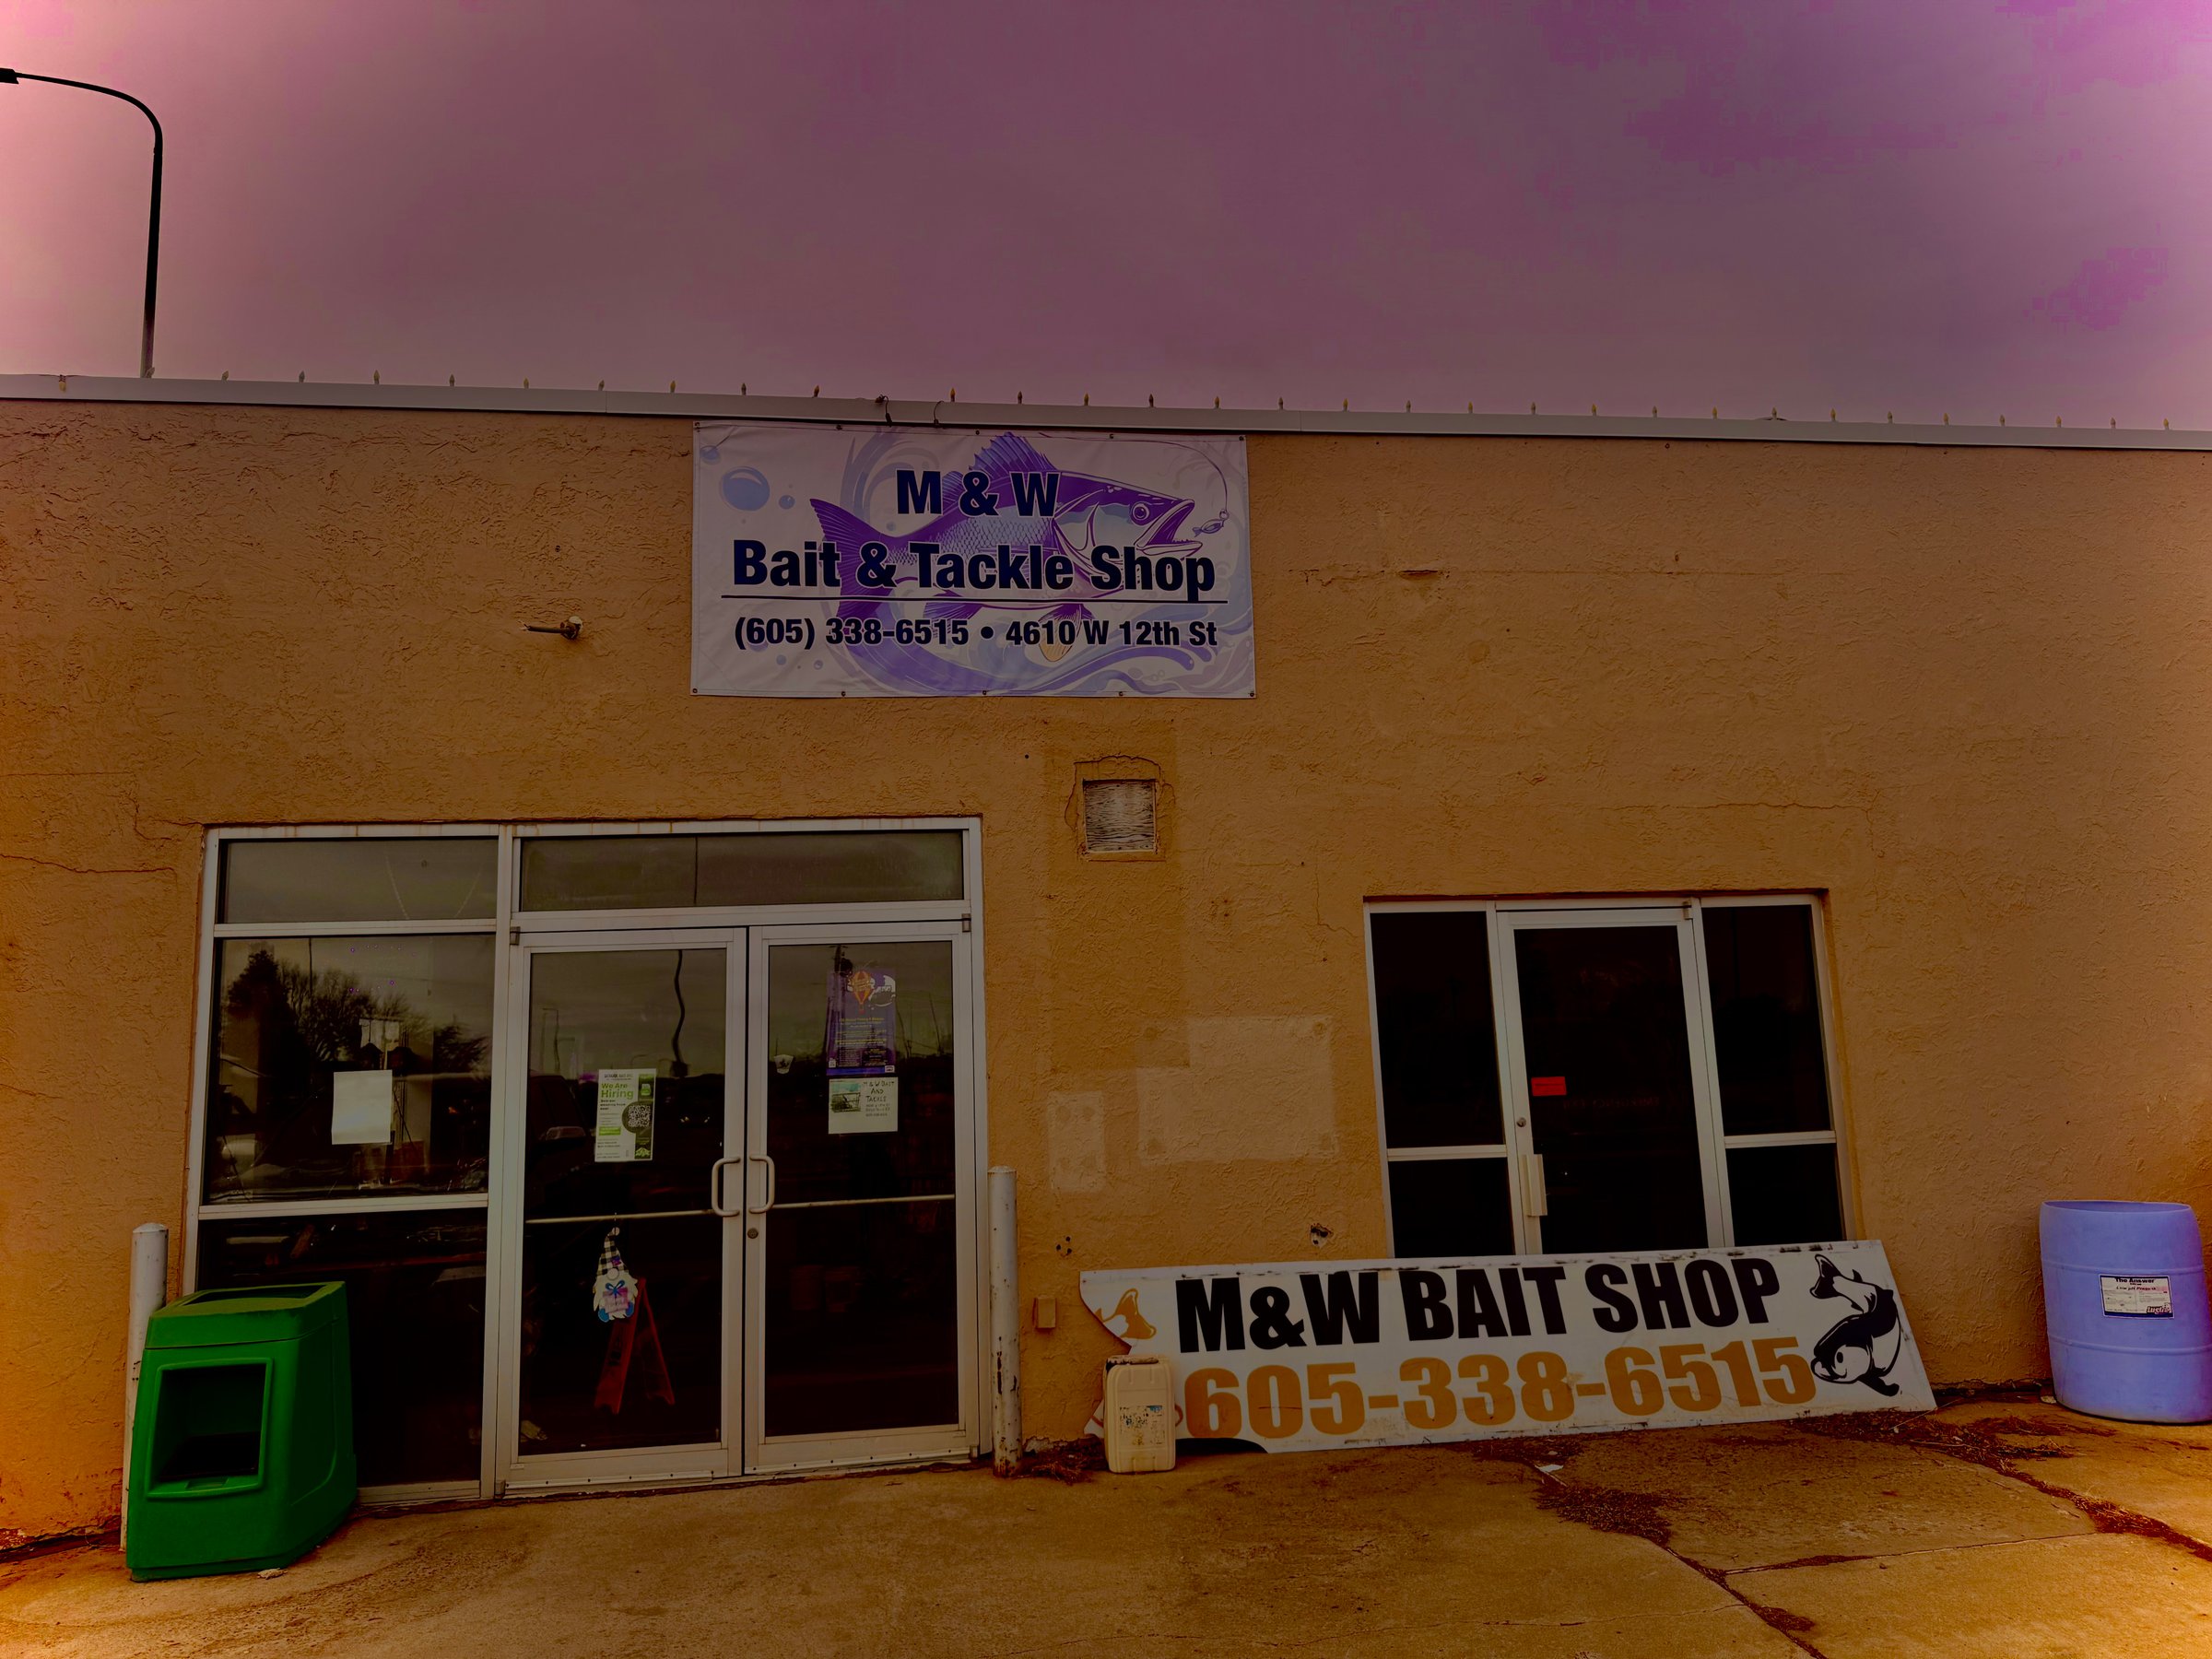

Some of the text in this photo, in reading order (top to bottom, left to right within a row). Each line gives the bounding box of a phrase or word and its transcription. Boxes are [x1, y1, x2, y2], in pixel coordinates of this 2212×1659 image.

[896, 469, 1061, 516] M & W
[734, 539, 1216, 602] Bait & Tackle Shop
[735, 617, 1218, 650] (605) 338-6515 4610 W 12th St
[601, 1088, 634, 1100] Hiring
[1175, 1257, 1781, 1354] M&W BAIT SHOP
[1183, 1336, 1818, 1439] 605-338-6515
